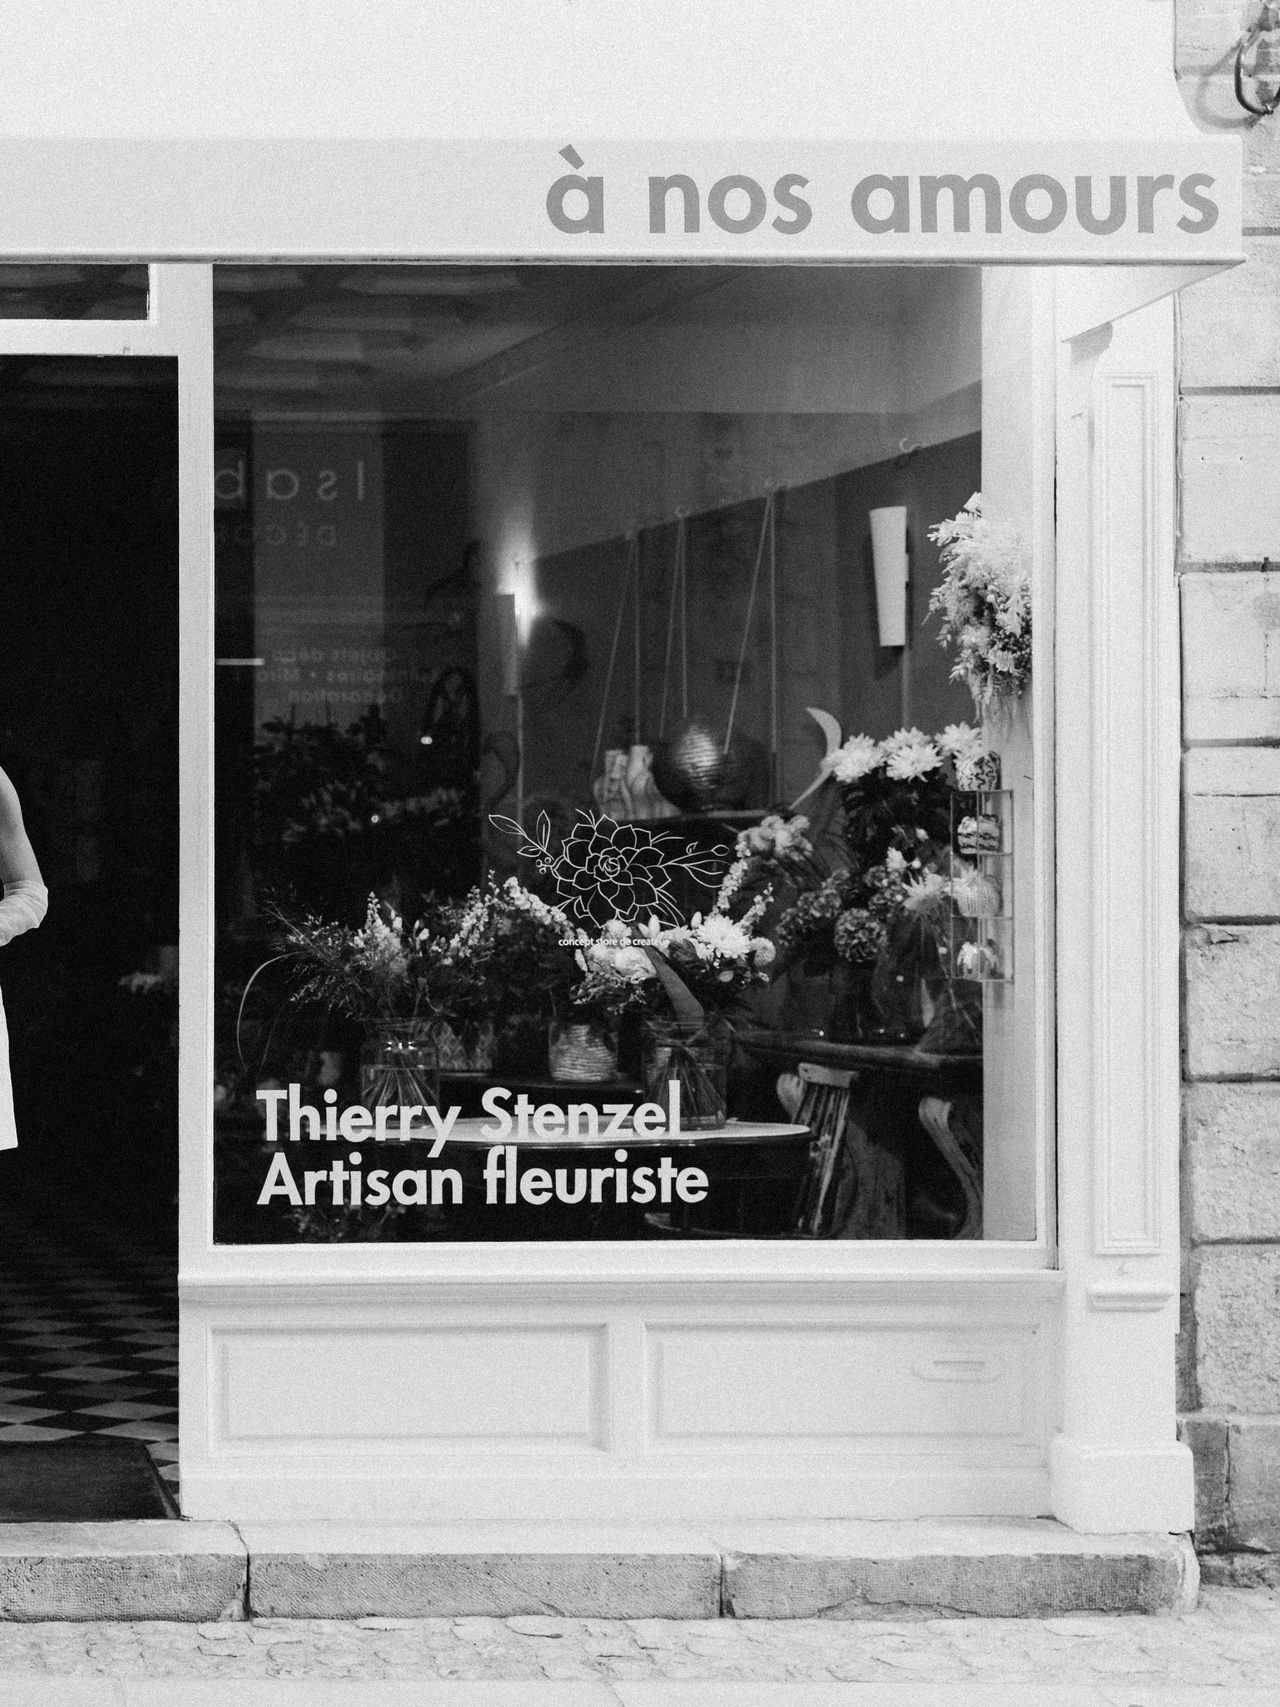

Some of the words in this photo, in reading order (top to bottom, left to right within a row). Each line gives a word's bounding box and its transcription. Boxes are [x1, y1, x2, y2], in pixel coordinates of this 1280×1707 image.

[545, 143, 605, 234] à
[649, 172, 813, 235] nos
[850, 172, 1220, 235] amours
[558, 937, 594, 948] concept
[595, 937, 618, 946] store
[619, 936, 632, 946] de
[256, 1083, 462, 1158] Thierry
[480, 1080, 681, 1139] Stenzel
[256, 1152, 463, 1206] Artisan
[483, 1145, 709, 1205] fleuriste
